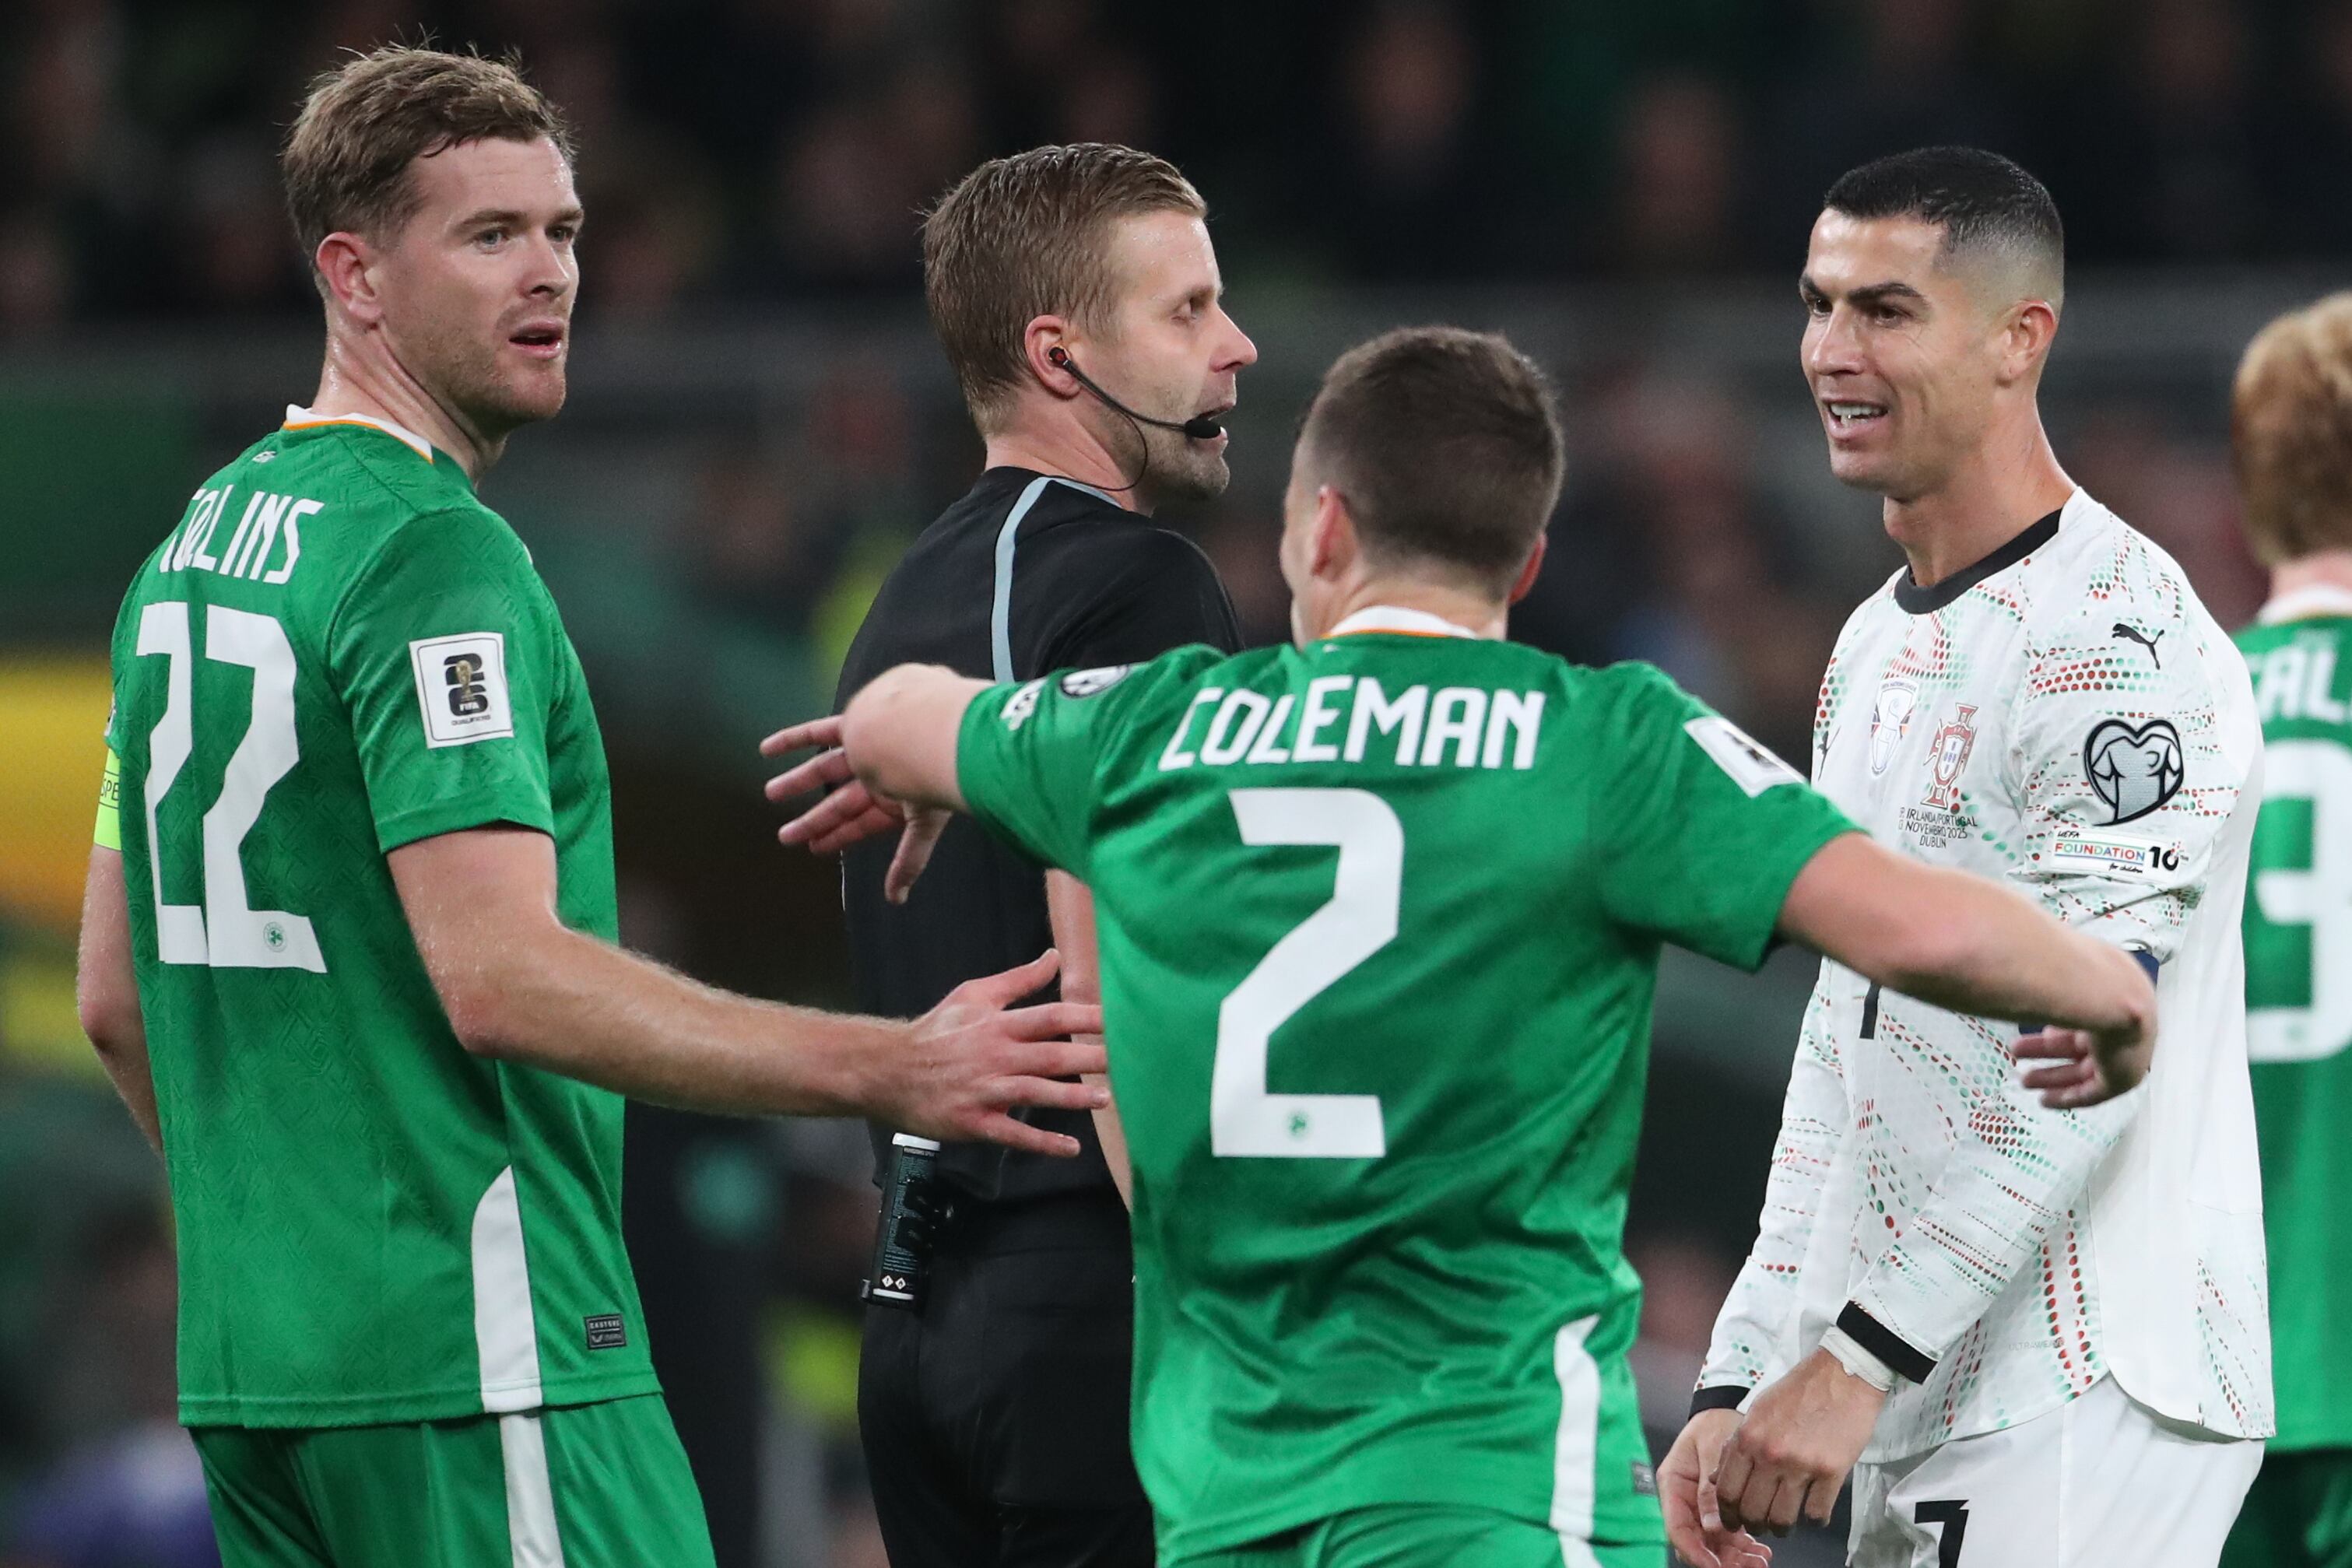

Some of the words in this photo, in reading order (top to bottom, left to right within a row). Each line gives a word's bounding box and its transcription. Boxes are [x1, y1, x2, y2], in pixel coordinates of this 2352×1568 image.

[135, 601, 328, 973] 22
[1157, 674, 1546, 772] COLEMAN
[1947, 826, 1968, 840] 2025
[1211, 787, 1404, 1158] 2
